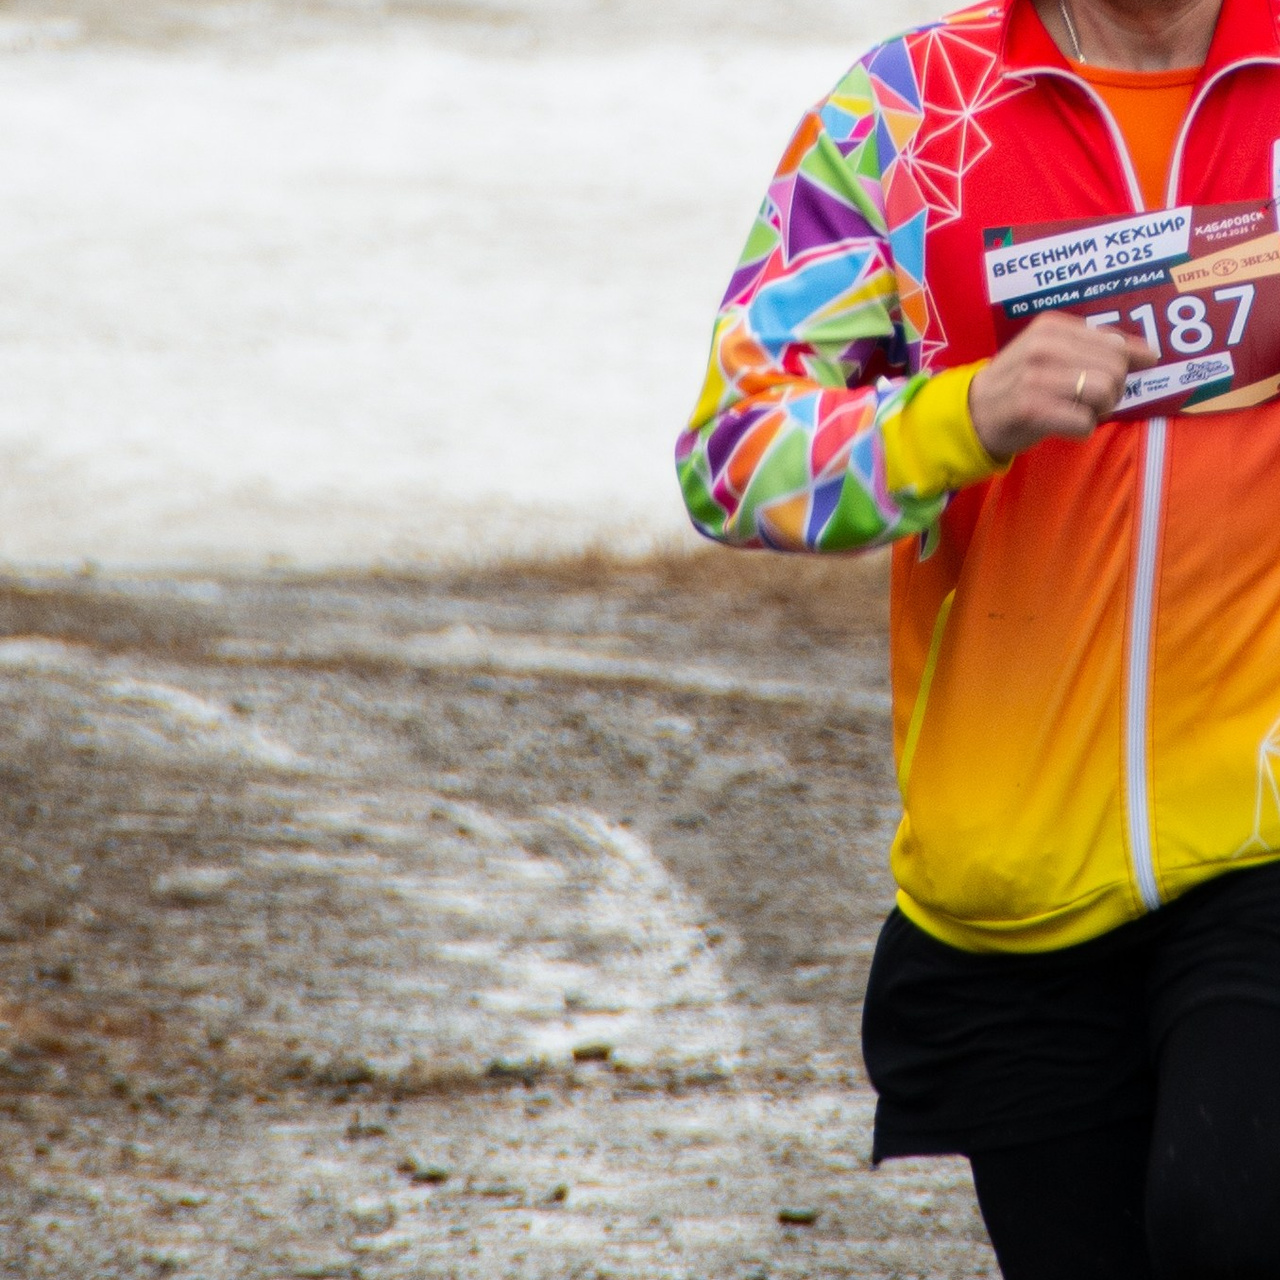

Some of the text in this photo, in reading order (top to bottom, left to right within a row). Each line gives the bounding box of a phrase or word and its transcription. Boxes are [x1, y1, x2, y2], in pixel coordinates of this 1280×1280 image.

[1194, 211, 1265, 236] ХАБАРОВСК
[993, 216, 1186, 278] ВЕСЕННИЙ ХЕХЦИР
[1034, 243, 1154, 287] ТРЕЙЛ 2025
[1177, 267, 1211, 284] ПЯТЬ
[1240, 250, 1280, 270] ЗВЕЗД
[1012, 270, 1165, 315] ПО ТРОПАМ ДЕРСУ УЗАЛА
